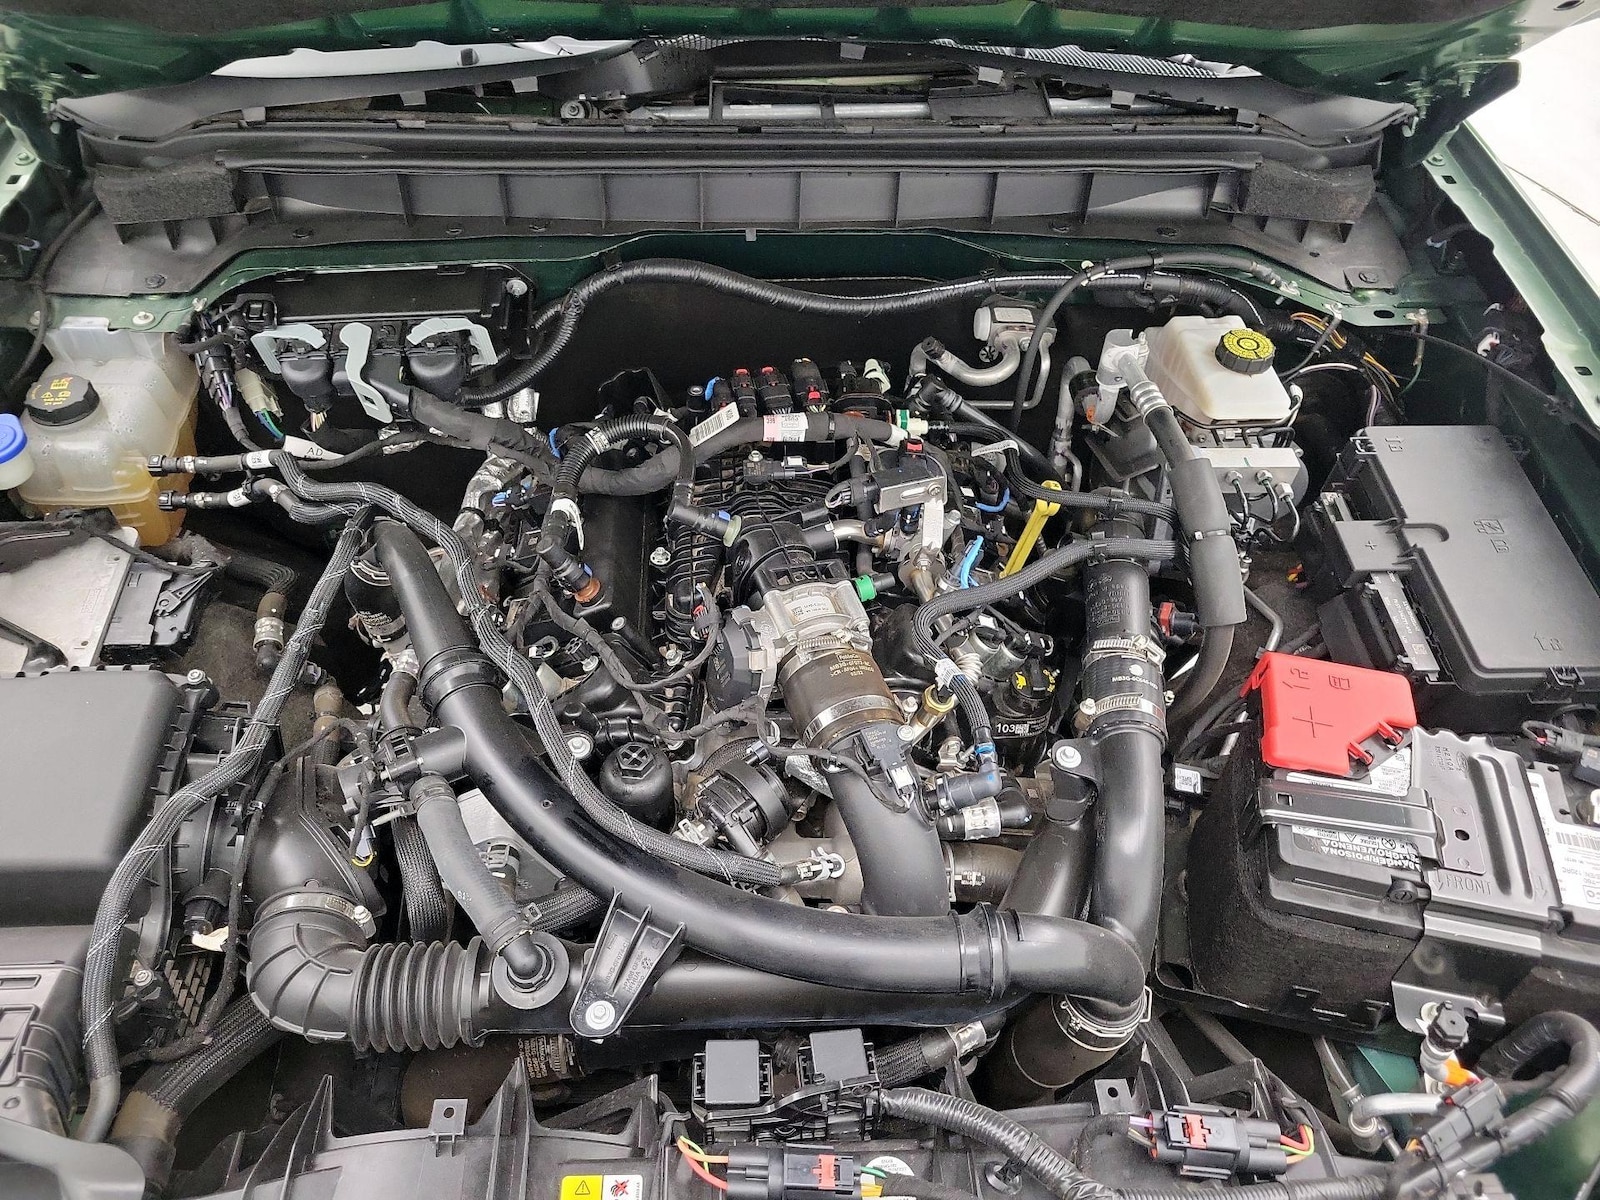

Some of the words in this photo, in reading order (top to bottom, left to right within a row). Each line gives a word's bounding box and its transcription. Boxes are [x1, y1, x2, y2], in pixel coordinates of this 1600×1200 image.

[307, 447, 324, 456] AD
[996, 722, 1016, 734] 103
[1329, 848, 1415, 870] DANGER/POISON
[1446, 875, 1492, 896] FRONT
